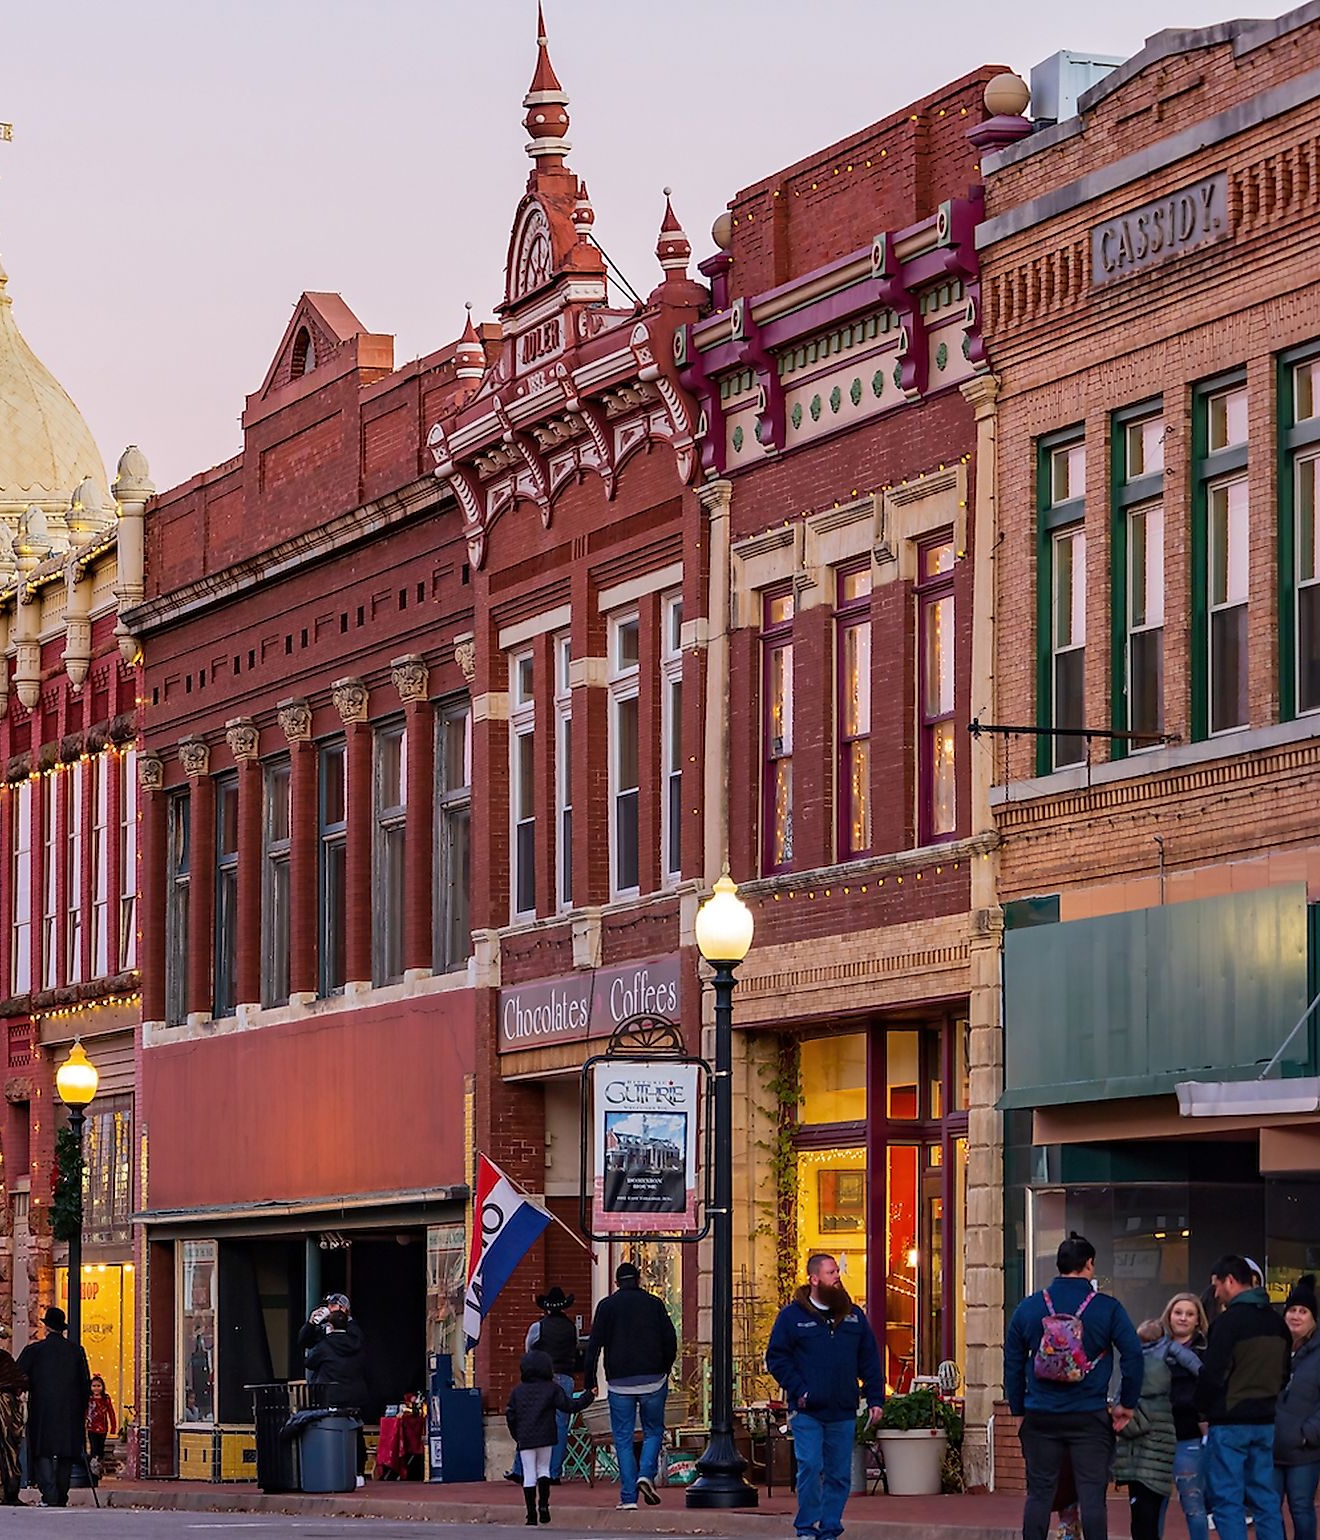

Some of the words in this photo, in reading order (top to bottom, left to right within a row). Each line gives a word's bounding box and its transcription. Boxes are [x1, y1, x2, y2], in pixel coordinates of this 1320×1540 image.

[522, 319, 560, 365] ADLER
[504, 988, 589, 1040] Chocolates
[610, 970, 678, 1022] Coffees
[605, 1081, 686, 1107] GUTHRIE
